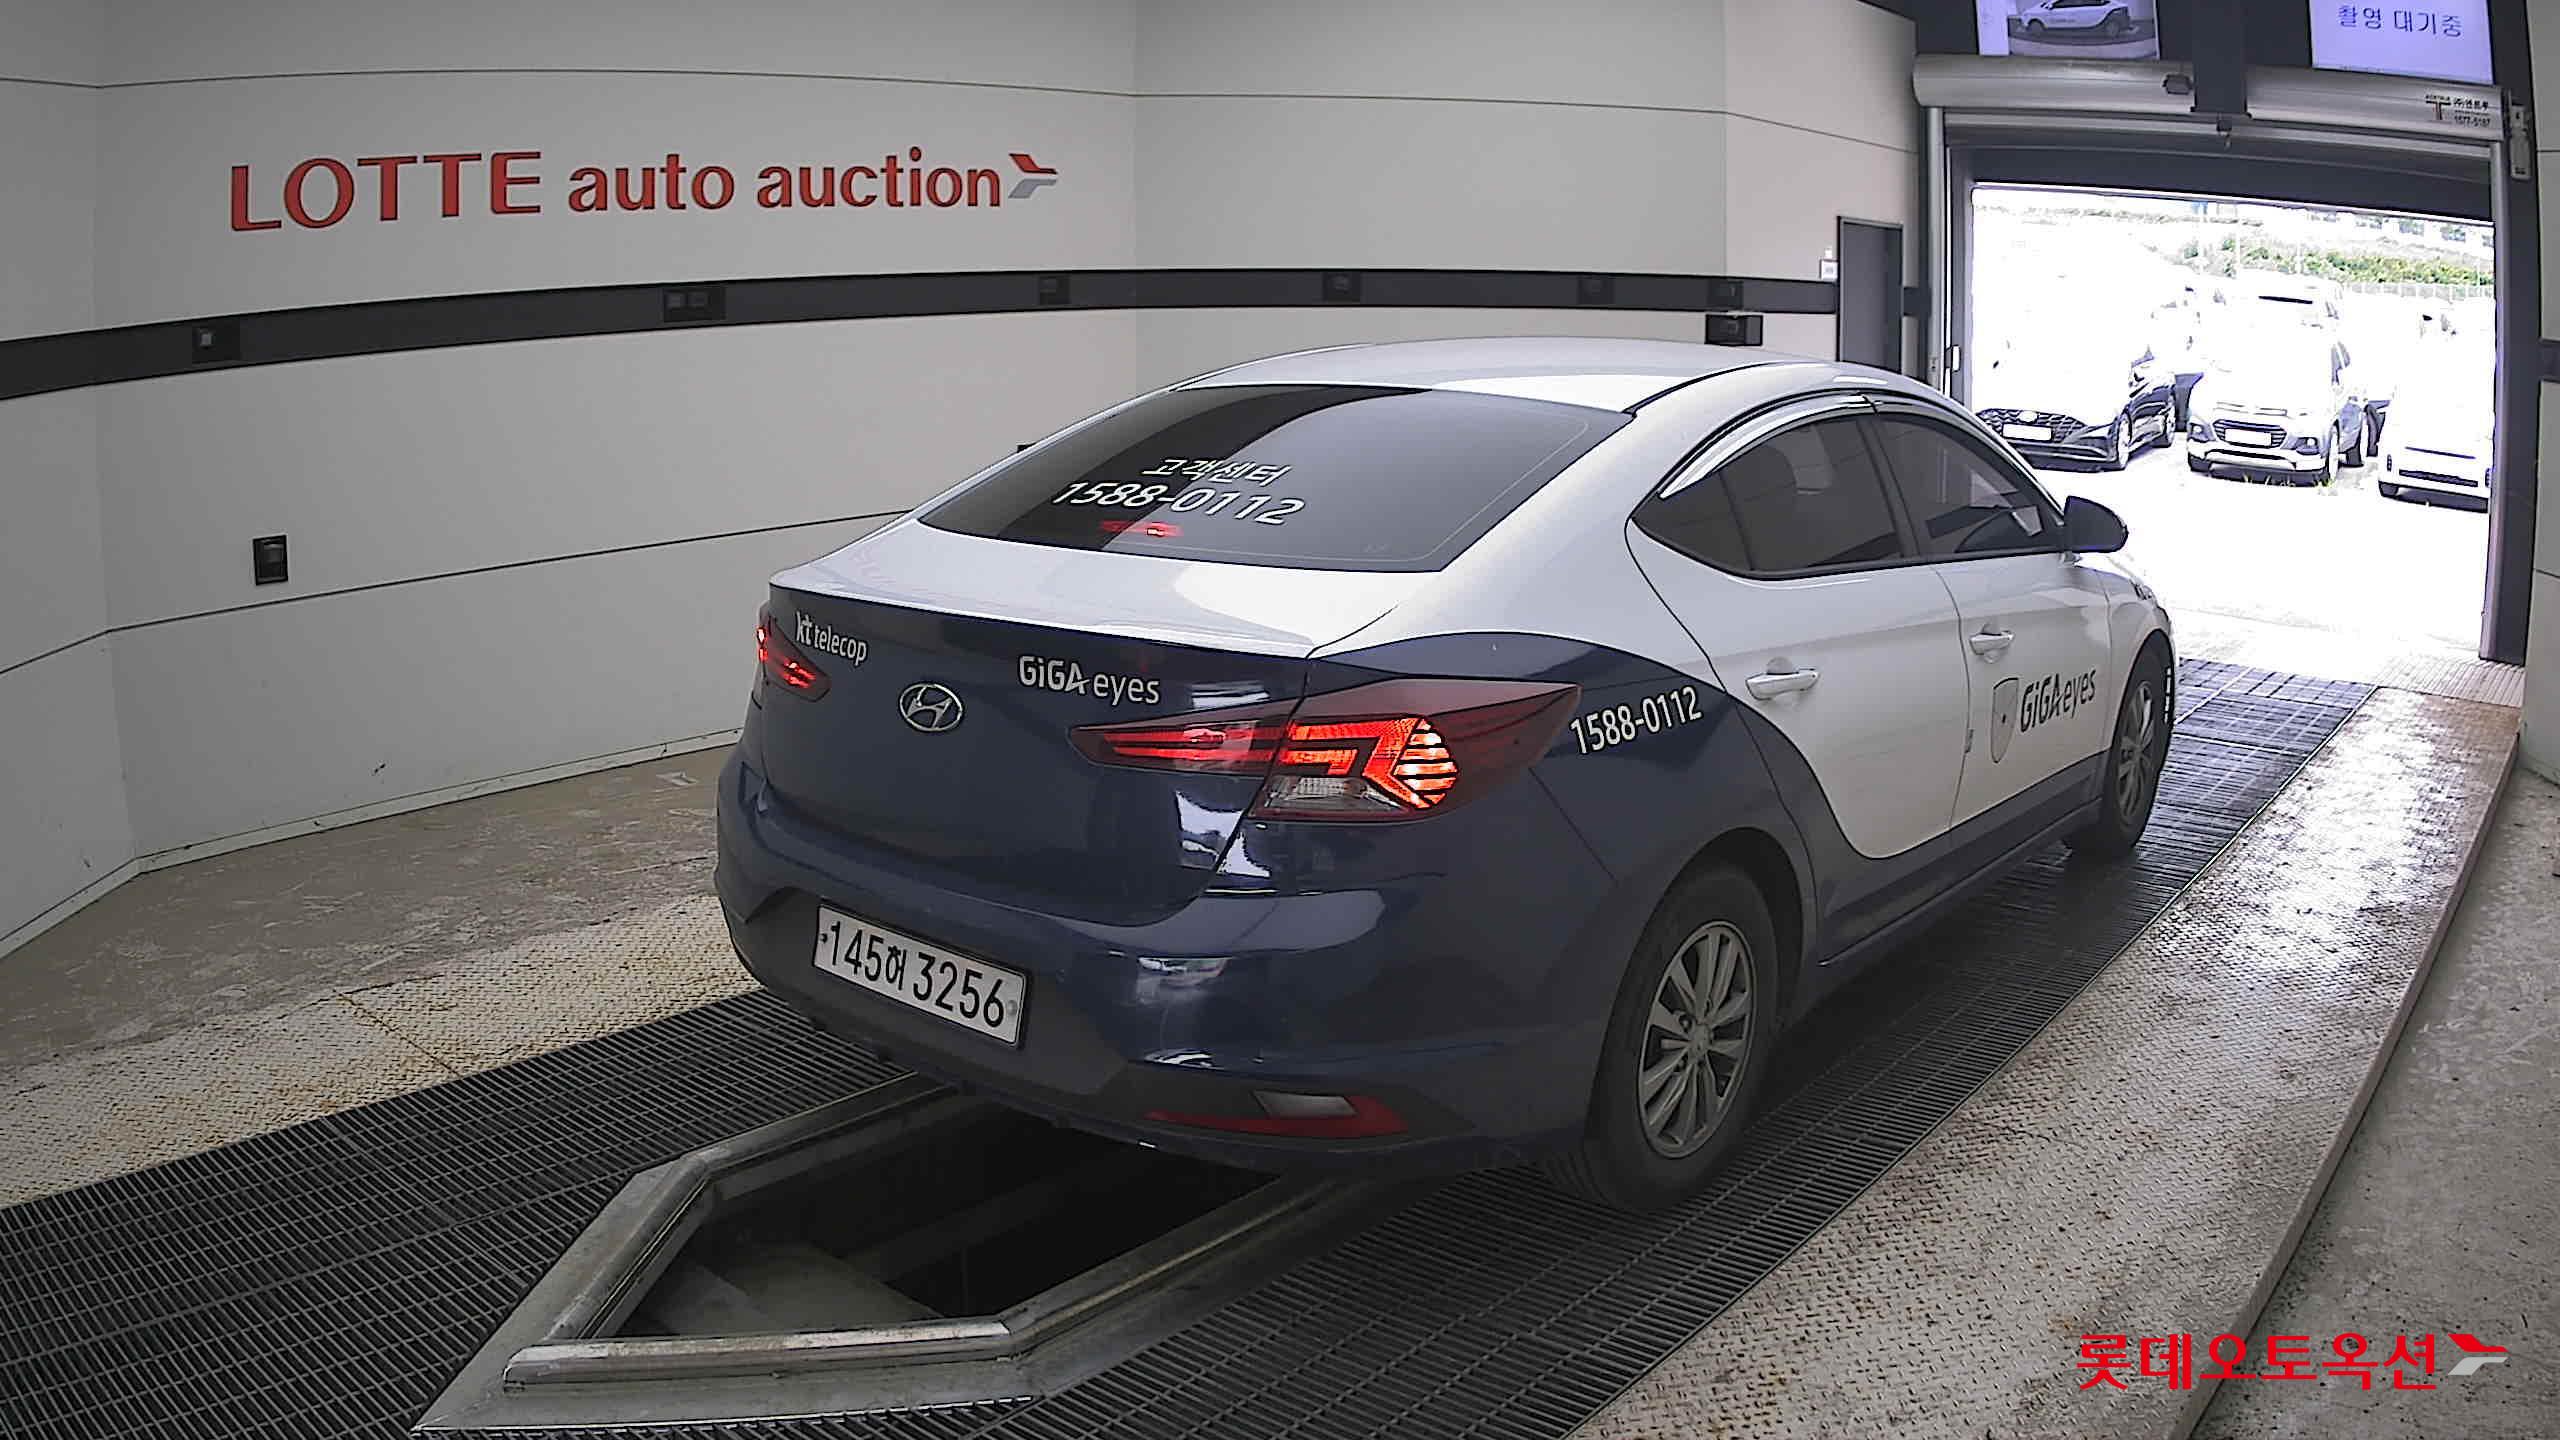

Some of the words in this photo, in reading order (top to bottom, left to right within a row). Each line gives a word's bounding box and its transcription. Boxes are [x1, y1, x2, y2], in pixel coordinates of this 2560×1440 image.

[2338, 5, 2383, 30] 촬영
[2393, 10, 2462, 38] 대기중
[231, 151, 542, 232] LOTTE
[567, 152, 735, 212] auto
[756, 146, 1001, 209] auction
[1142, 458, 1291, 487] 고객센터
[1052, 481, 1306, 526] 1588-0112
[796, 610, 813, 646] kt
[814, 624, 868, 667] telecop
[1019, 655, 1089, 695] GiGA
[1092, 669, 1160, 706] eyes
[1570, 685, 1702, 754] 1588-0112
[830, 920, 907, 991] 145허
[912, 951, 1005, 1028] 3256
